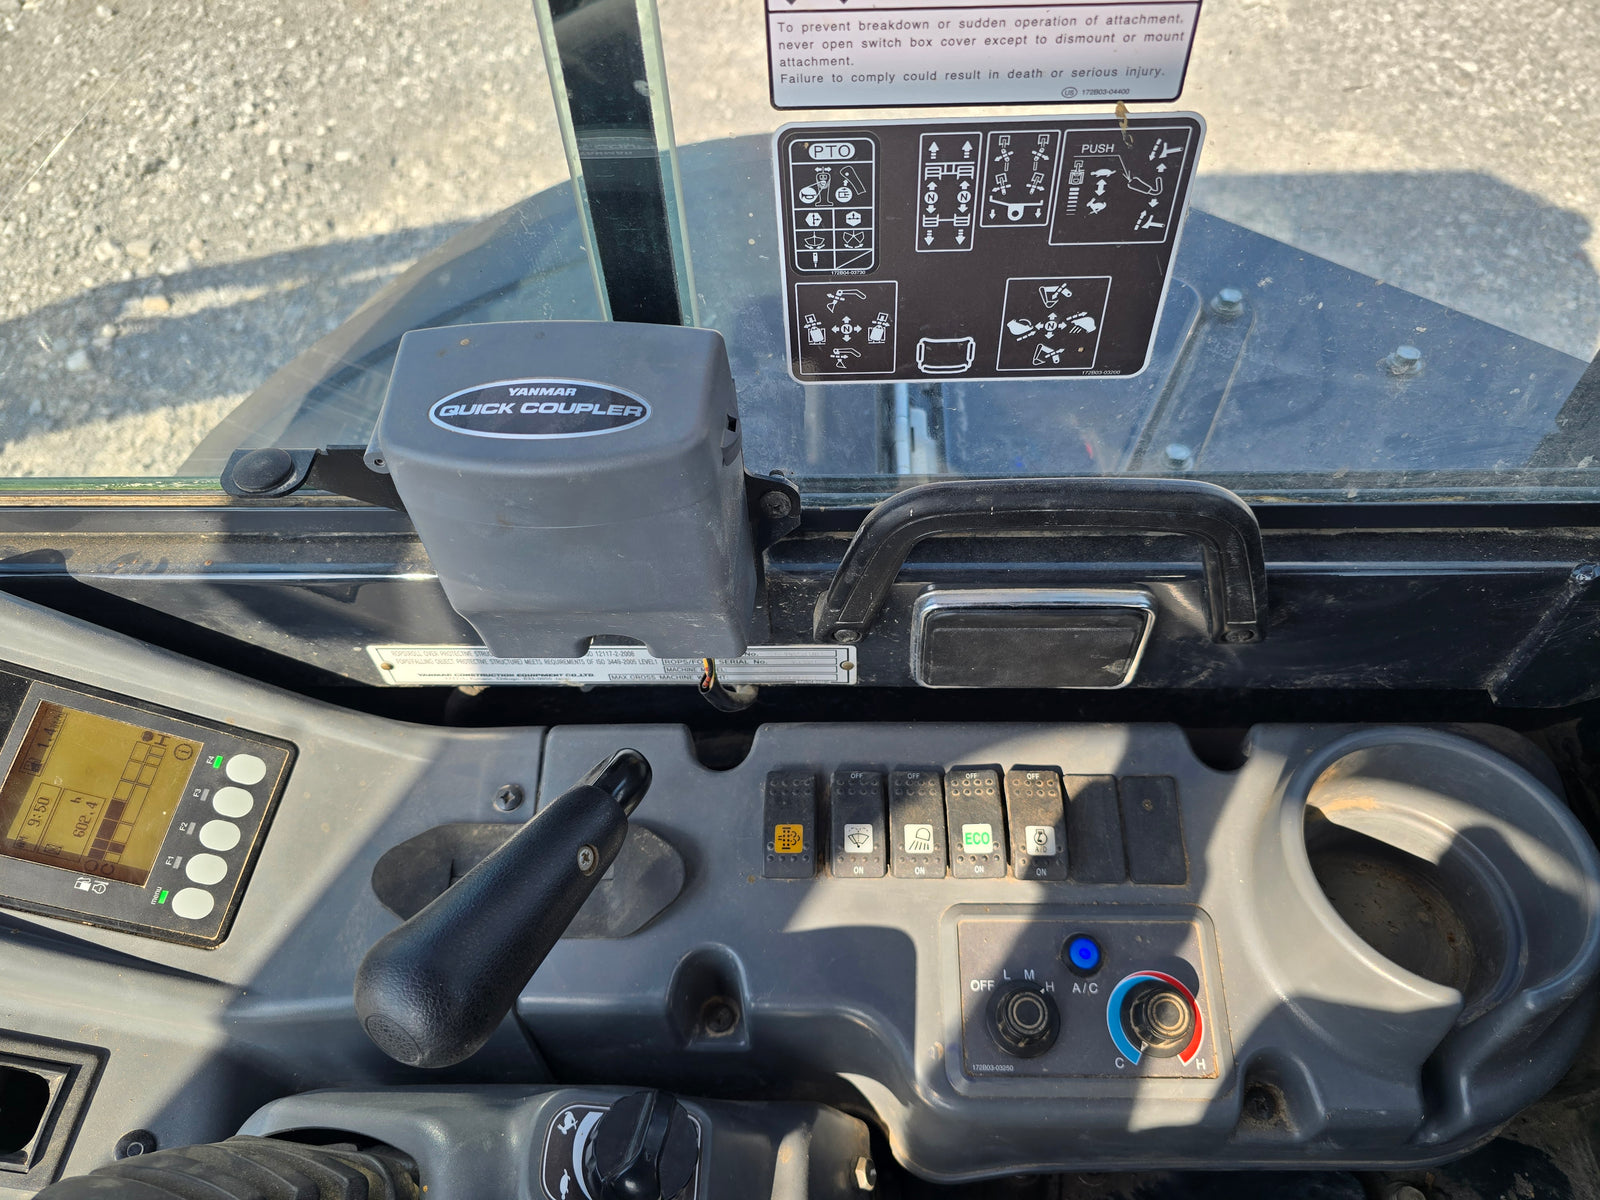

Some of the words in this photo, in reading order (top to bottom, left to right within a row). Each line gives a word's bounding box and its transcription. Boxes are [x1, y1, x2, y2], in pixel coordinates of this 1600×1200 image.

[777, 22, 794, 33] To
[801, 22, 851, 35] prevent
[858, 20, 930, 31] breakdown
[937, 20, 951, 30] or
[958, 17, 1006, 29] sudden
[1014, 16, 1077, 29] operation
[1085, 15, 1099, 26] of
[1105, 13, 1184, 26] attachment.
[778, 40, 814, 50] never
[822, 40, 853, 51] open
[861, 37, 901, 48] switch
[910, 37, 932, 48] box
[940, 37, 976, 47] cover
[984, 35, 1027, 47] except
[1035, 34, 1047, 45] to
[1055, 32, 1116, 45] dismount
[1122, 34, 1136, 43] or
[1143, 31, 1185, 43] mount
[779, 56, 854, 67] attachment.
[780, 73, 824, 84] Failure
[832, 73, 843, 83] to
[851, 71, 896, 85] comply
[903, 71, 937, 81] could
[945, 70, 981, 81] result
[988, 69, 1000, 79] in
[1007, 68, 1043, 79] death
[1050, 69, 1064, 78] or
[1071, 67, 1118, 78] serious
[1125, 65, 1166, 79] injury.
[813, 145, 851, 158] PTO
[1081, 143, 1115, 154] PUSH
[960, 193, 968, 201] N
[508, 387, 577, 397] YANMAR
[438, 402, 516, 418] QUICK
[519, 402, 644, 418] COUPLER
[206, 756, 215, 765] F4
[193, 789, 202, 798] F3
[27, 797, 50, 828] 9:50
[73, 801, 98, 838] 602.4
[179, 822, 189, 832] F2
[964, 832, 990, 845] ECO
[165, 856, 175, 866] F1
[853, 866, 864, 875] ON
[914, 867, 925, 875] ON
[974, 865, 985, 874] ON
[1036, 867, 1047, 876] ON
[150, 886, 162, 905] menu
[1003, 970, 1011, 980] L
[1023, 969, 1035, 981] M
[970, 979, 995, 992] OFF
[1046, 981, 1055, 992] H
[1072, 982, 1098, 994] A/C
[1115, 1057, 1125, 1069] C
[1195, 1058, 1206, 1071] H
